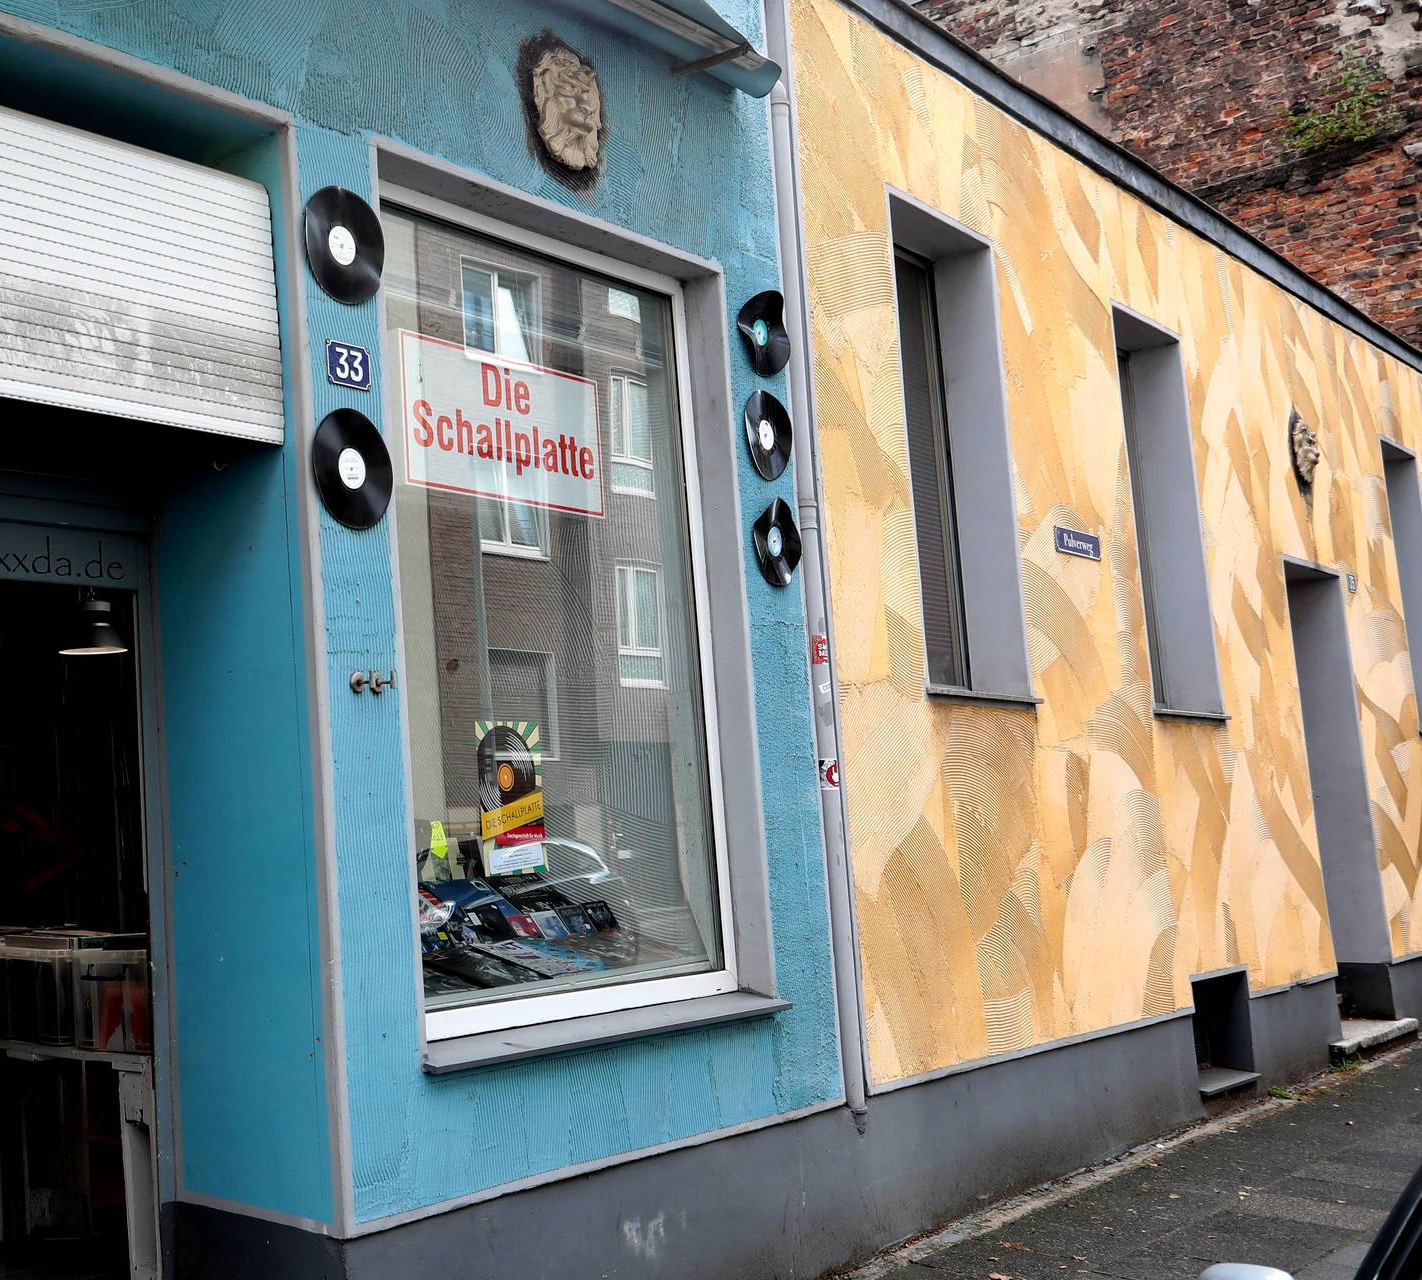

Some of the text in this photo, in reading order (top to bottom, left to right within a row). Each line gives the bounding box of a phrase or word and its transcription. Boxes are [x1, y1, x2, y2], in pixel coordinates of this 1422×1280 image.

[335, 346, 364, 382] 33
[480, 362, 531, 416] Die
[412, 399, 595, 481] Schallplatte
[485, 800, 541, 830] DIE SCHALLPLATTE
